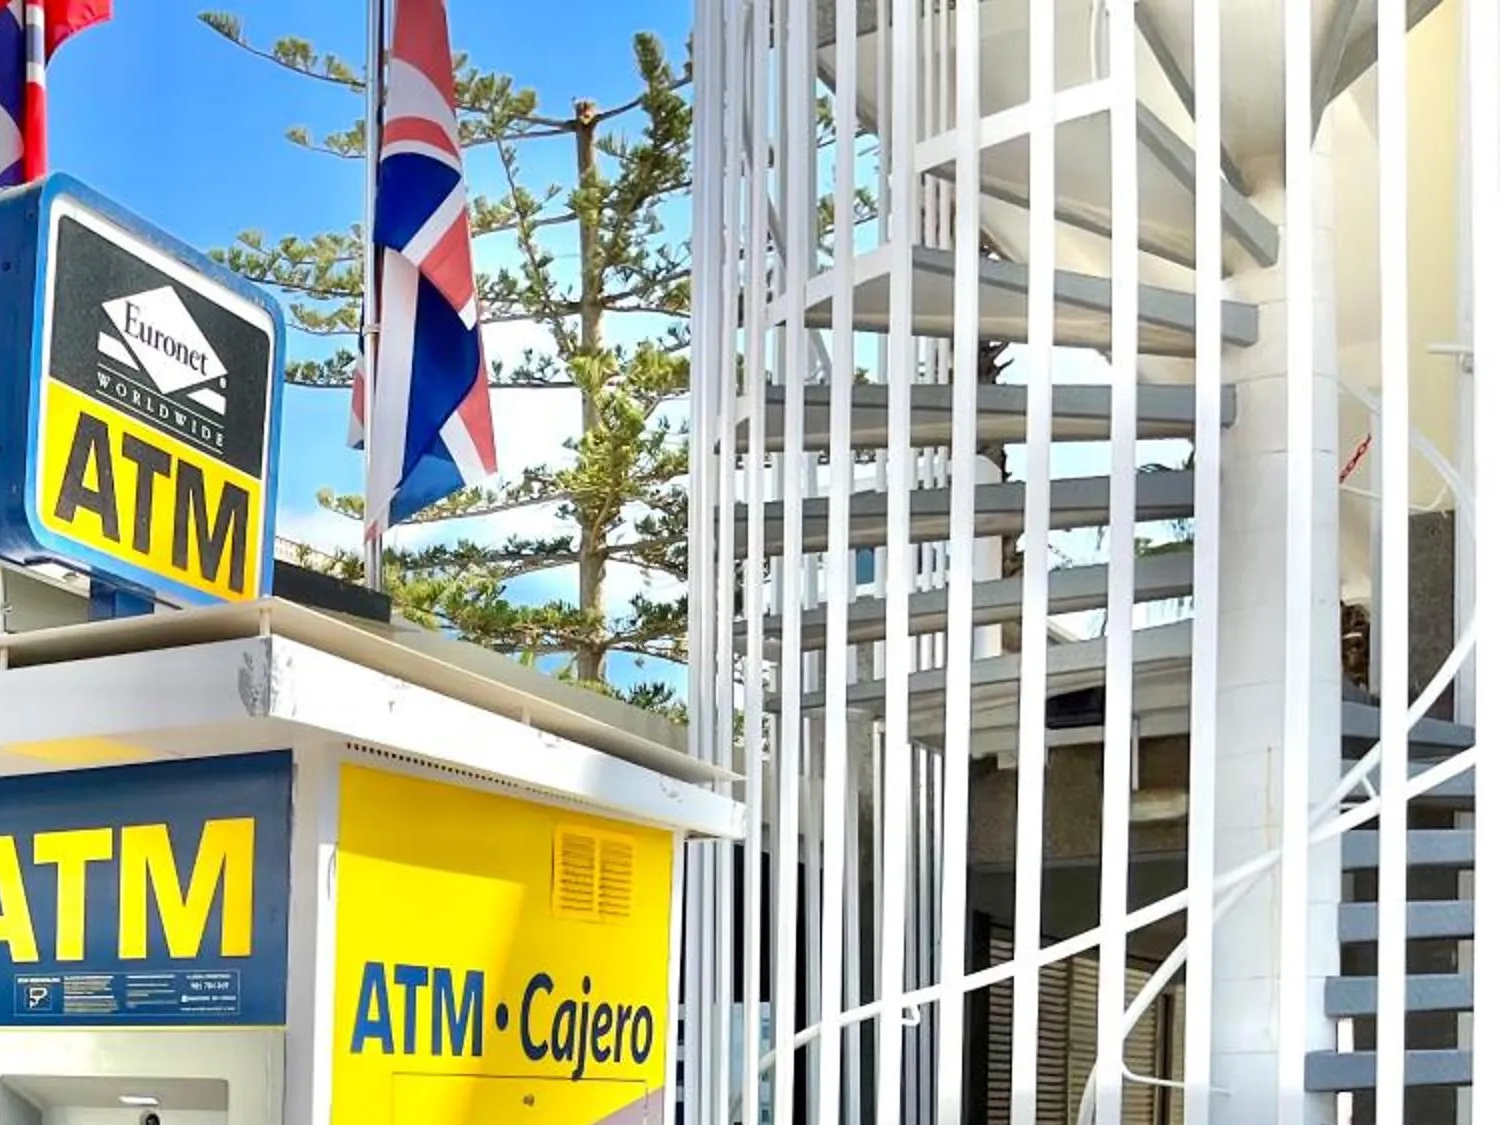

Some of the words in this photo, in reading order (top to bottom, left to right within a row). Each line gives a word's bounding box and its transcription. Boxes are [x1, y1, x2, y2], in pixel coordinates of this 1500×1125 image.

[124, 300, 209, 377] Euronet
[97, 371, 225, 448] WORLDWIDE
[54, 410, 250, 595] ATM
[350, 960, 484, 1057] ATM
[521, 973, 653, 1081] Cajero
